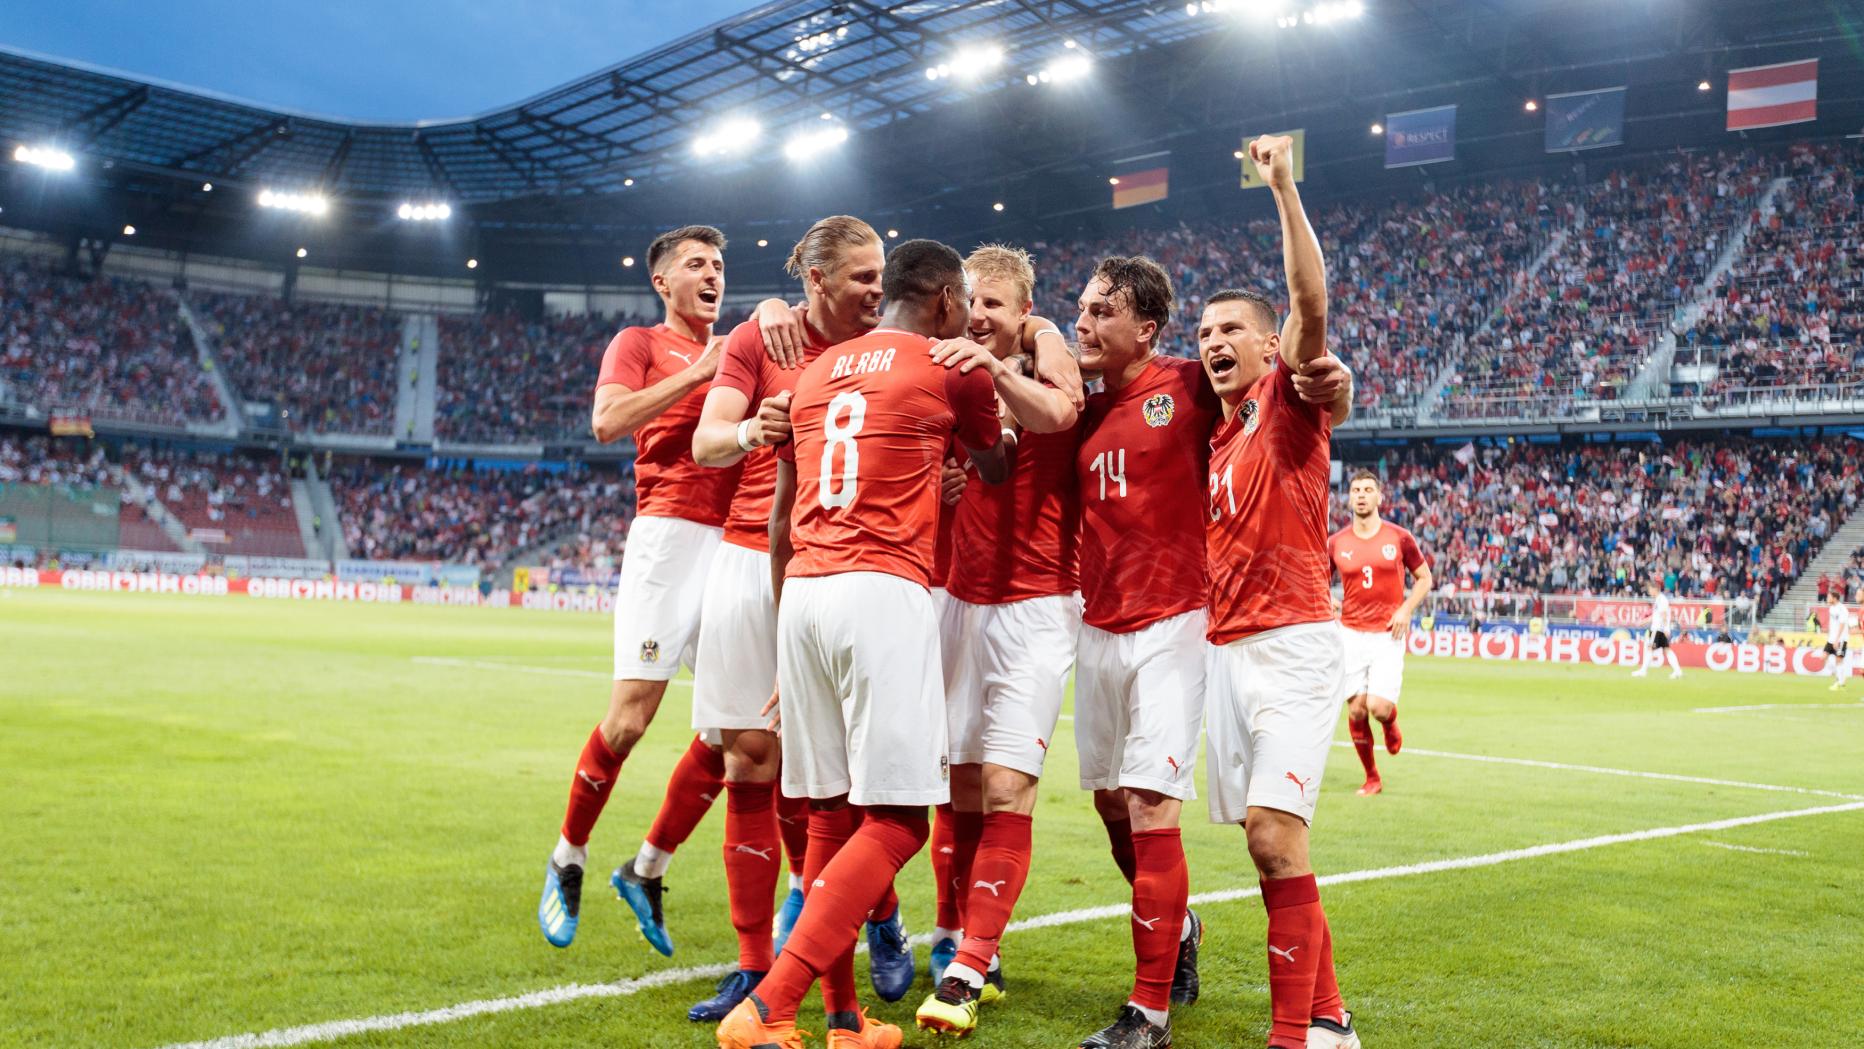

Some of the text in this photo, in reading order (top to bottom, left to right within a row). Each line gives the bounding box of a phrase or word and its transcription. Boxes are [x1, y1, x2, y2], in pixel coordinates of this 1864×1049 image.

[831, 348, 896, 378] ALABA
[819, 391, 867, 510] 8
[1090, 448, 1127, 501] 14
[1362, 565, 1373, 589] 3
